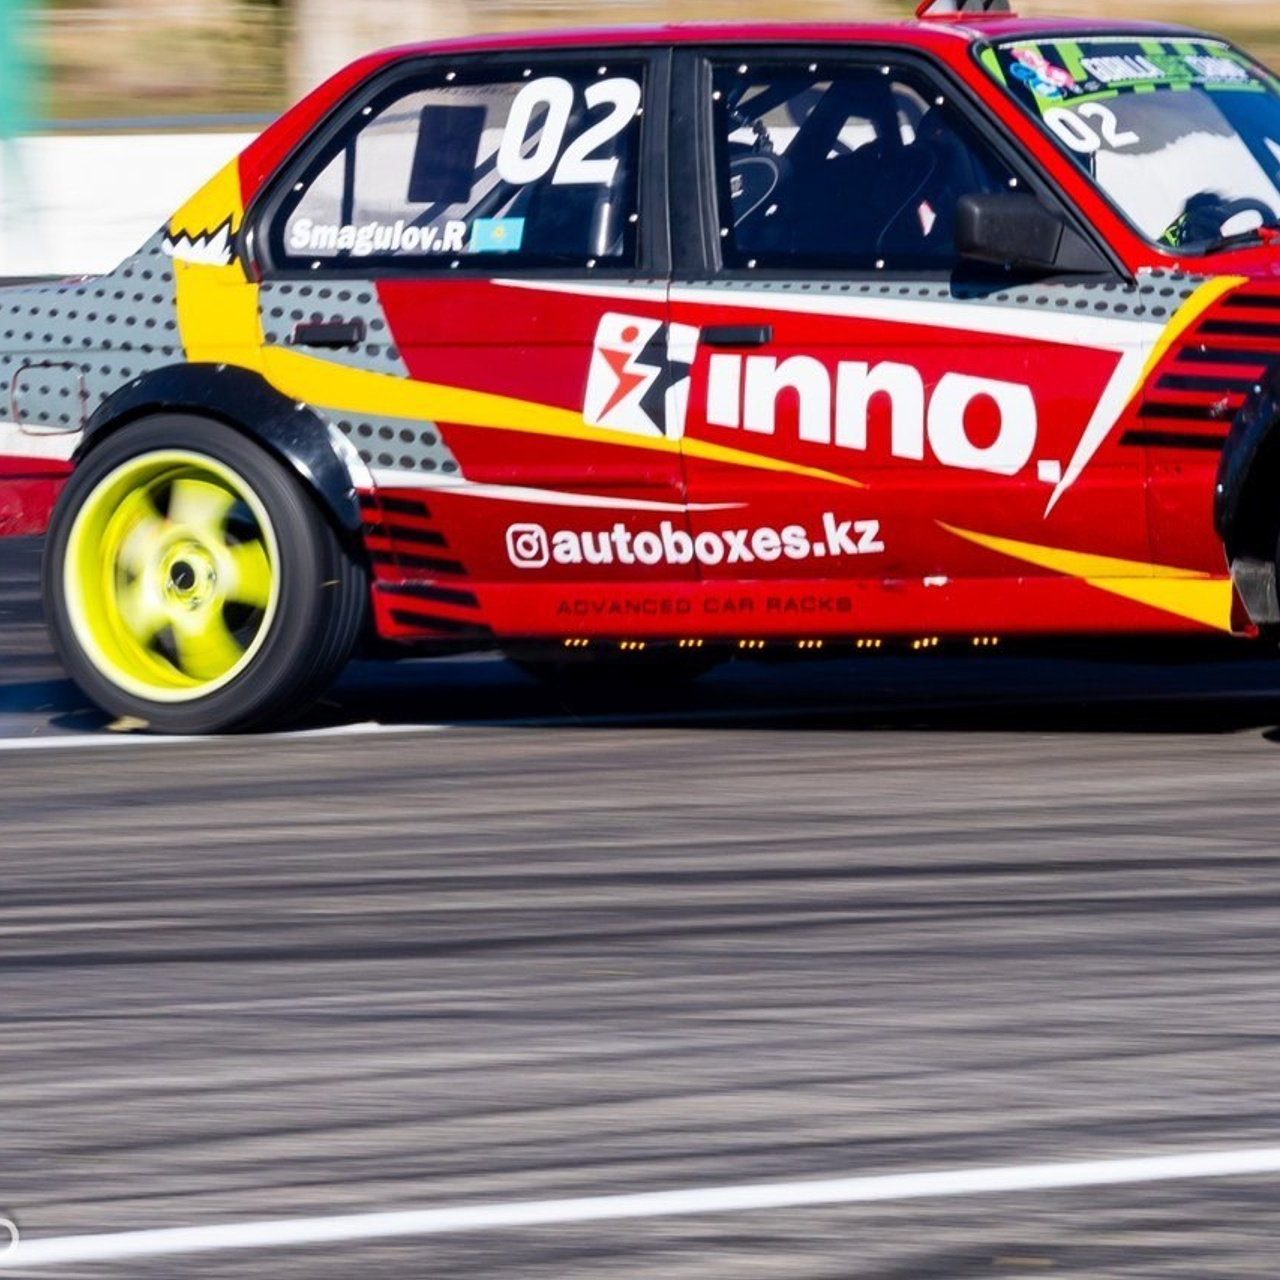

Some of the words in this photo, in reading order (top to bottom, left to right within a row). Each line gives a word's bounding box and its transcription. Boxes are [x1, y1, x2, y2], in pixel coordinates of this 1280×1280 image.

[499, 77, 642, 186] 02
[1043, 103, 1140, 153] 02
[290, 219, 467, 256] Smagulov.R
[551, 512, 885, 565] autoboxes.kz
[556, 597, 692, 616] ADVANCED
[703, 596, 754, 615] CAR
[766, 595, 853, 615] RACKS
